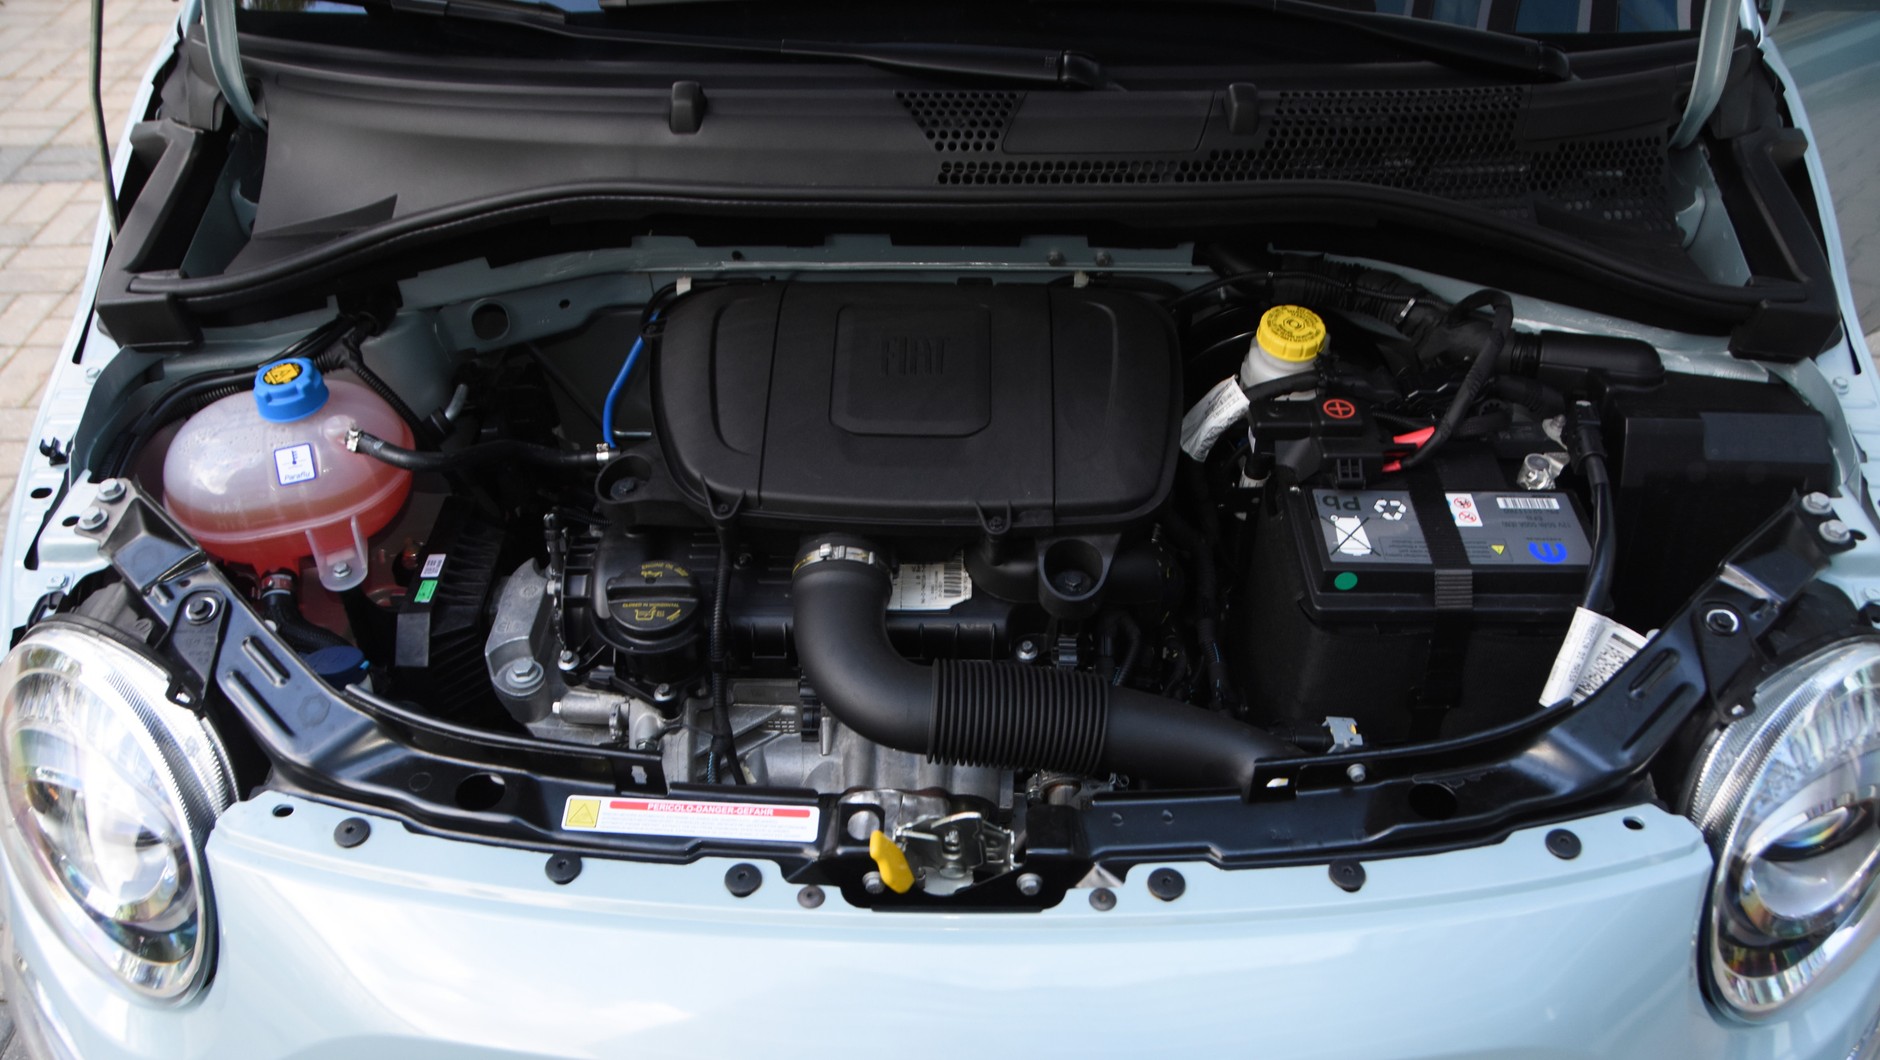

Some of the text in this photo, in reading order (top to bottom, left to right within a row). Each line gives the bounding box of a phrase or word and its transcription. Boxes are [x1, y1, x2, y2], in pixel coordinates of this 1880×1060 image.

[880, 335, 951, 376] FIAT
[1322, 495, 1362, 511] Pb
[647, 803, 774, 817] PERICOLO-DANGER-GEFAHR
